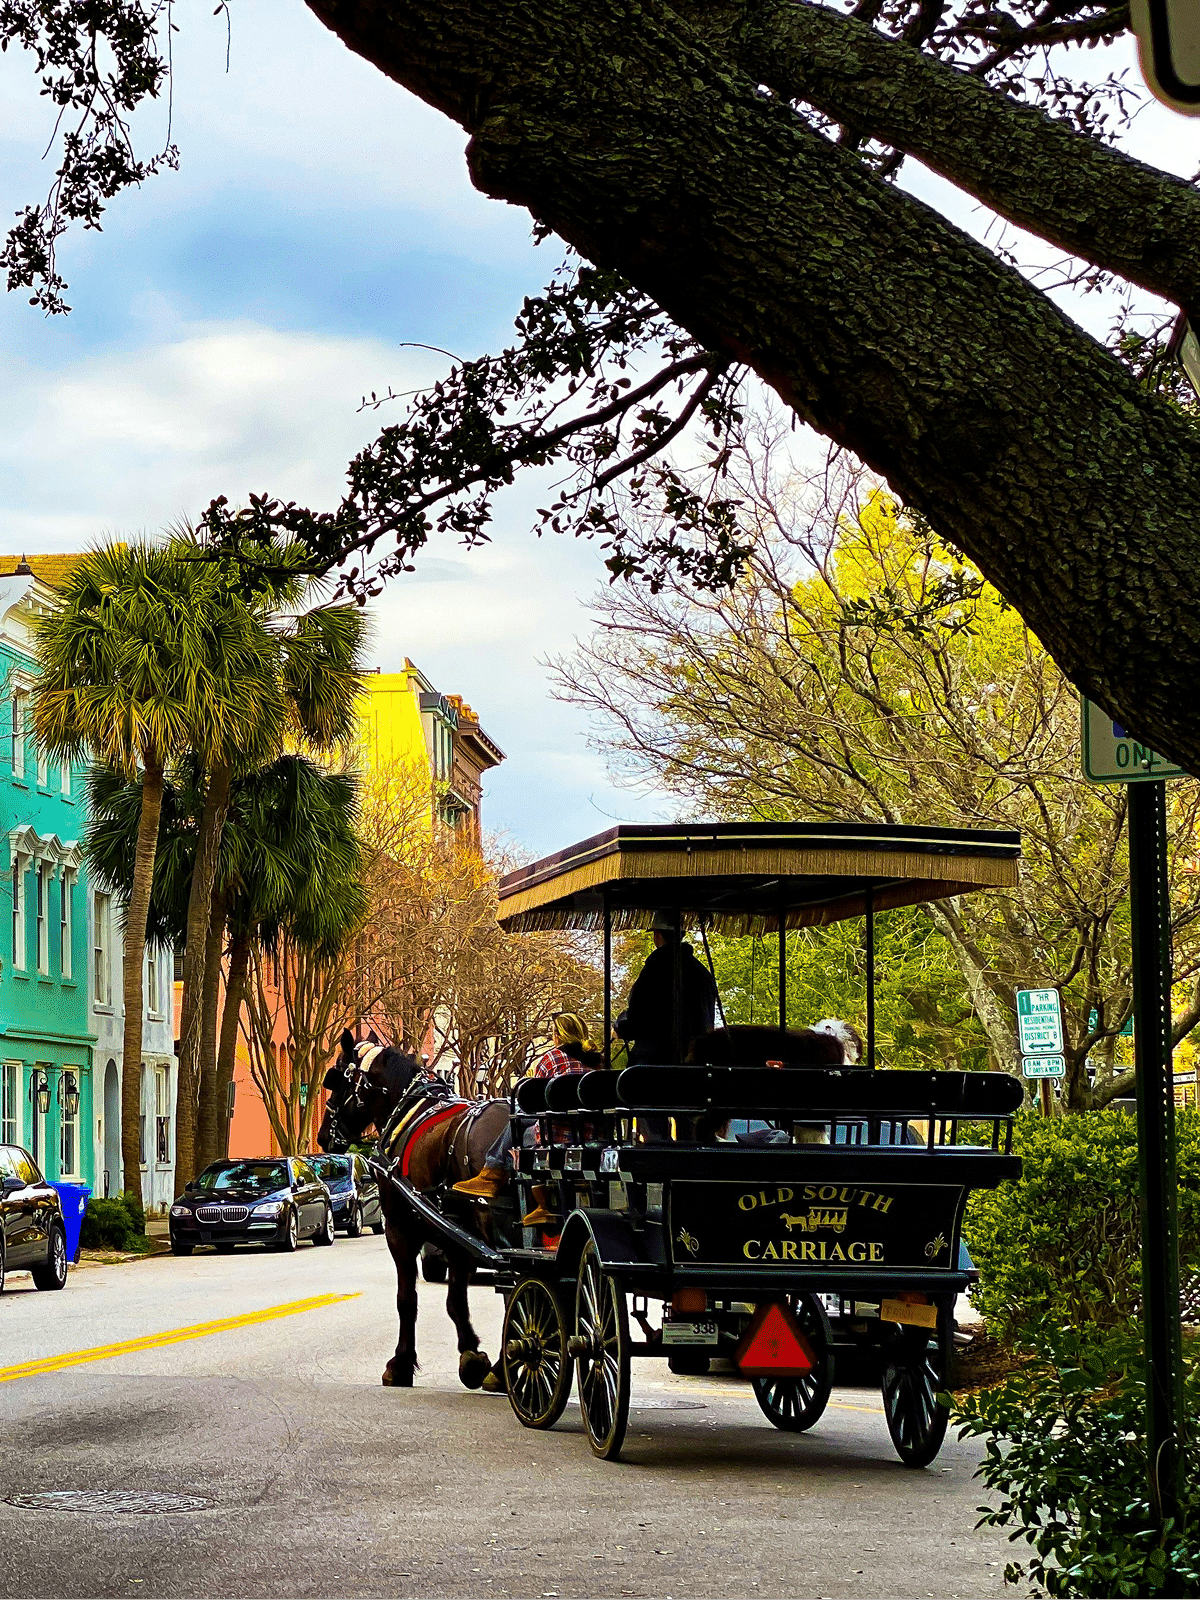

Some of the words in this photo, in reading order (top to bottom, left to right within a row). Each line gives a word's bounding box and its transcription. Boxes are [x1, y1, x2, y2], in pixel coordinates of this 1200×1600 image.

[1039, 993, 1050, 1001] HR
[1031, 1003, 1057, 1012] PARKING
[1024, 1016, 1055, 1025] RESIDENTIAL
[1025, 1032, 1050, 1041] DISTRICT
[738, 1187, 794, 1211] OLD
[802, 1185, 895, 1214] SOUTH
[742, 1240, 885, 1262] CARRIAGE
[692, 1322, 717, 1335] 338
